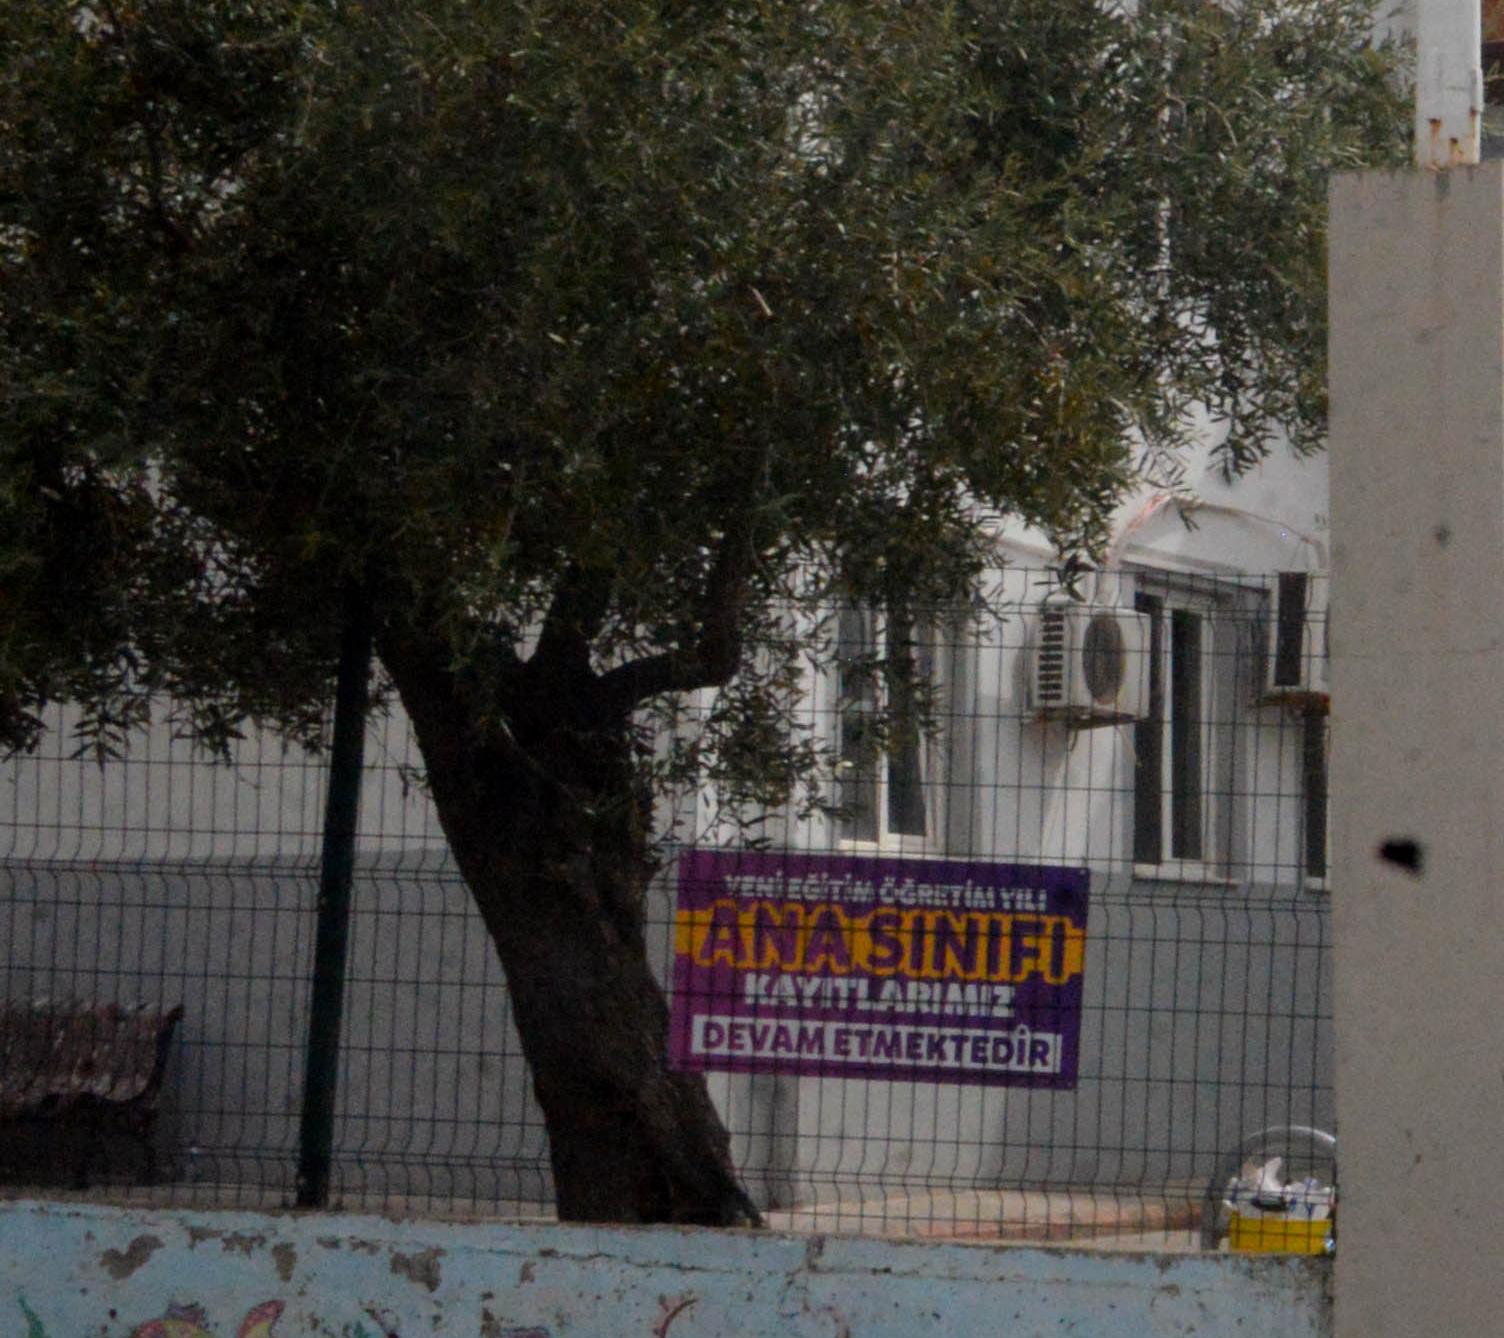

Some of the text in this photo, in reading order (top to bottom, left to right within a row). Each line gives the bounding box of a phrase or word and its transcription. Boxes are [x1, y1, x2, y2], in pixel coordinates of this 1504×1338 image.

[724, 870, 784, 899] YENİ
[787, 872, 875, 903] EĞİTİM
[999, 887, 1048, 911] YILI
[697, 900, 1069, 983] ANA SINIFI
[743, 972, 1015, 1017] KAYITLARIMIZ
[701, 1020, 1051, 1068] DEVAM ETMEKTEDİR
